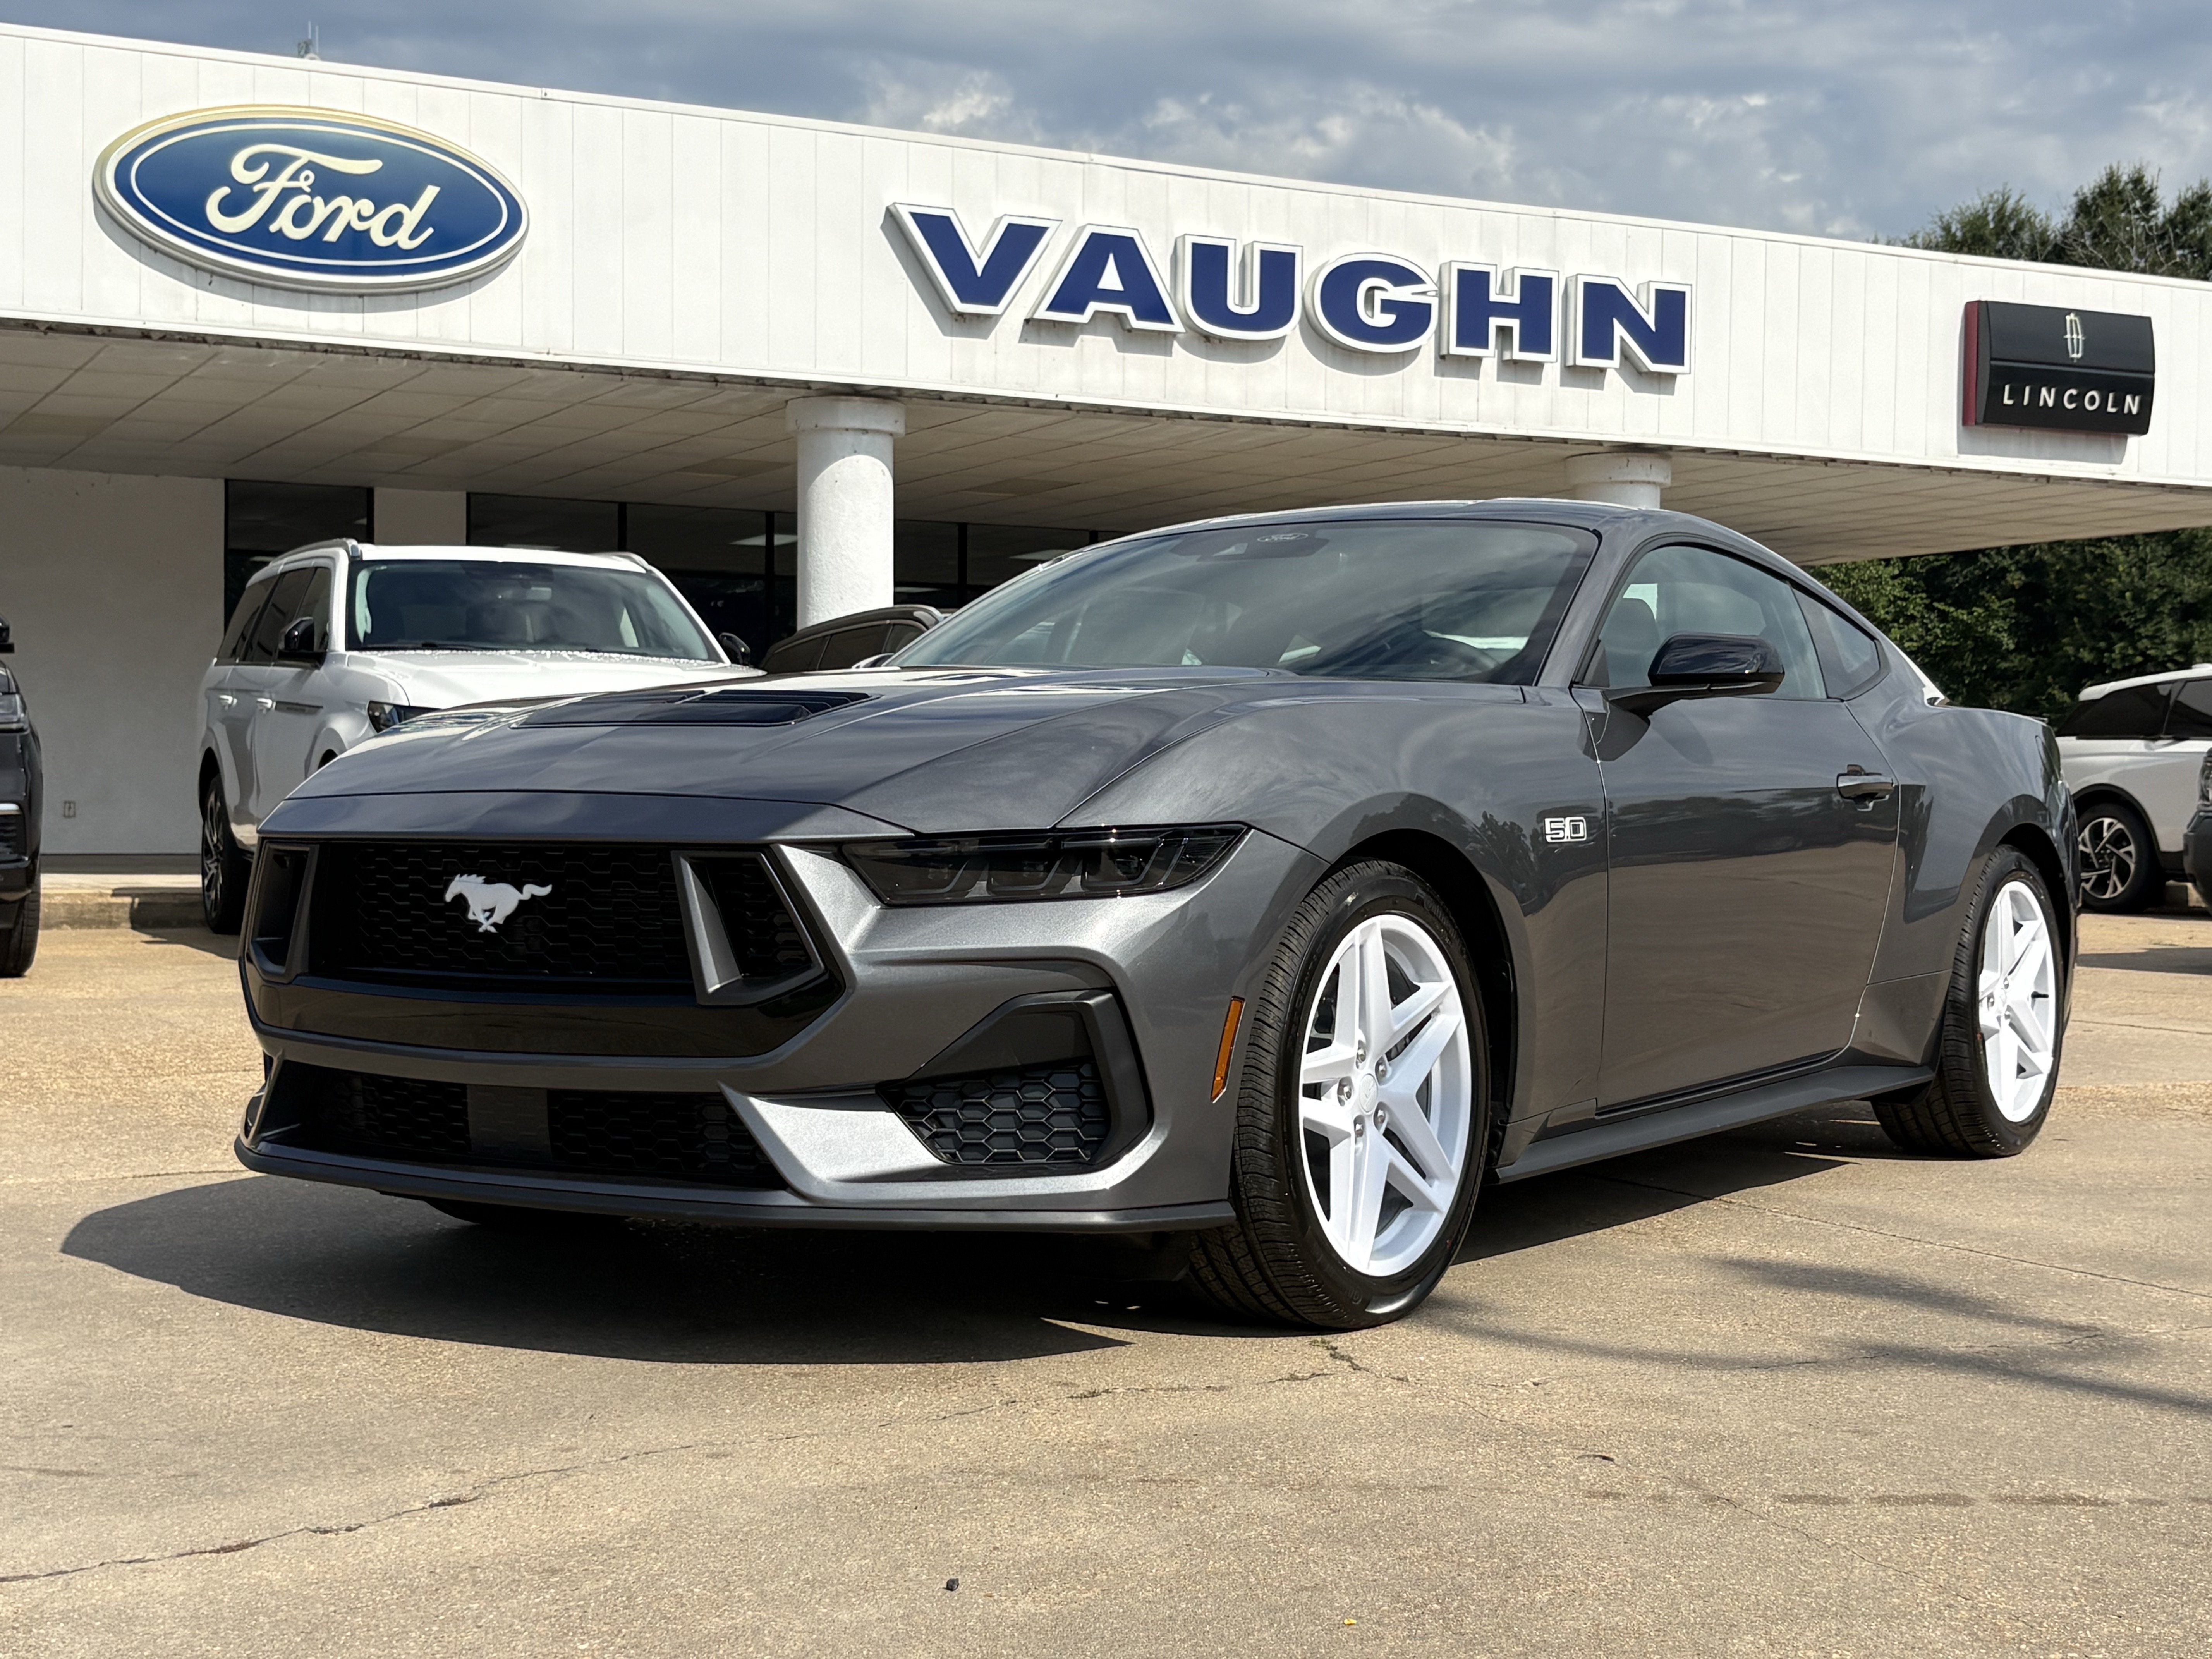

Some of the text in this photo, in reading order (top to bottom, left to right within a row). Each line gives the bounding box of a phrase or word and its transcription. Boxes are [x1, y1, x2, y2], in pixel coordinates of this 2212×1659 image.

[205, 143, 441, 250] Ford
[895, 203, 1691, 374] VAUGHN
[2002, 384, 2142, 415] LINCOLN
